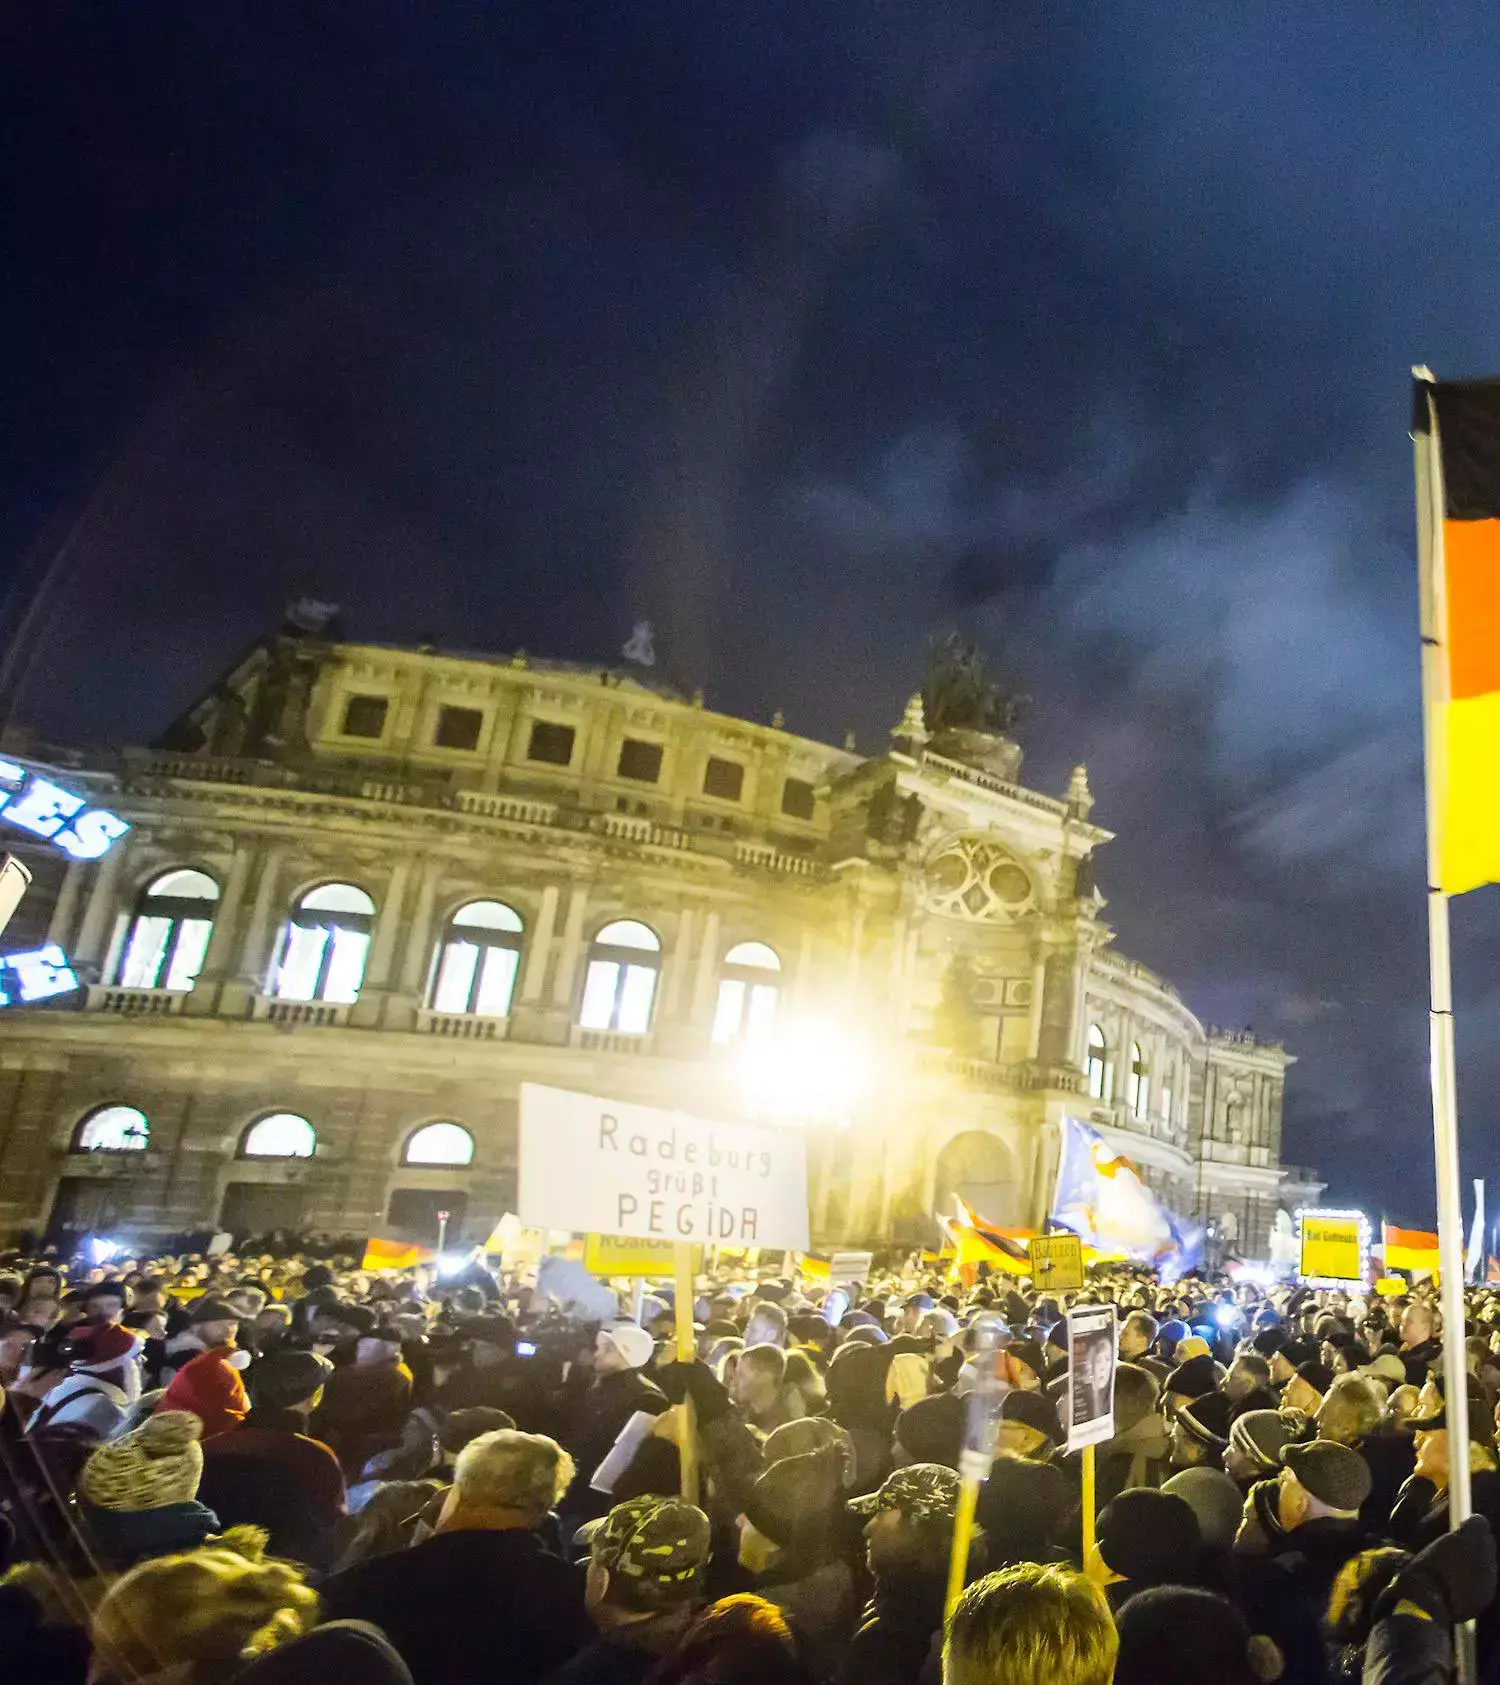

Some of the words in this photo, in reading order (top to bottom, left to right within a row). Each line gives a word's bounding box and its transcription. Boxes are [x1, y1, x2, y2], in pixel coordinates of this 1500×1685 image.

[0, 760, 131, 859] ES
[599, 1113, 772, 1178] Radeburg
[647, 1168, 718, 1198] grüßt
